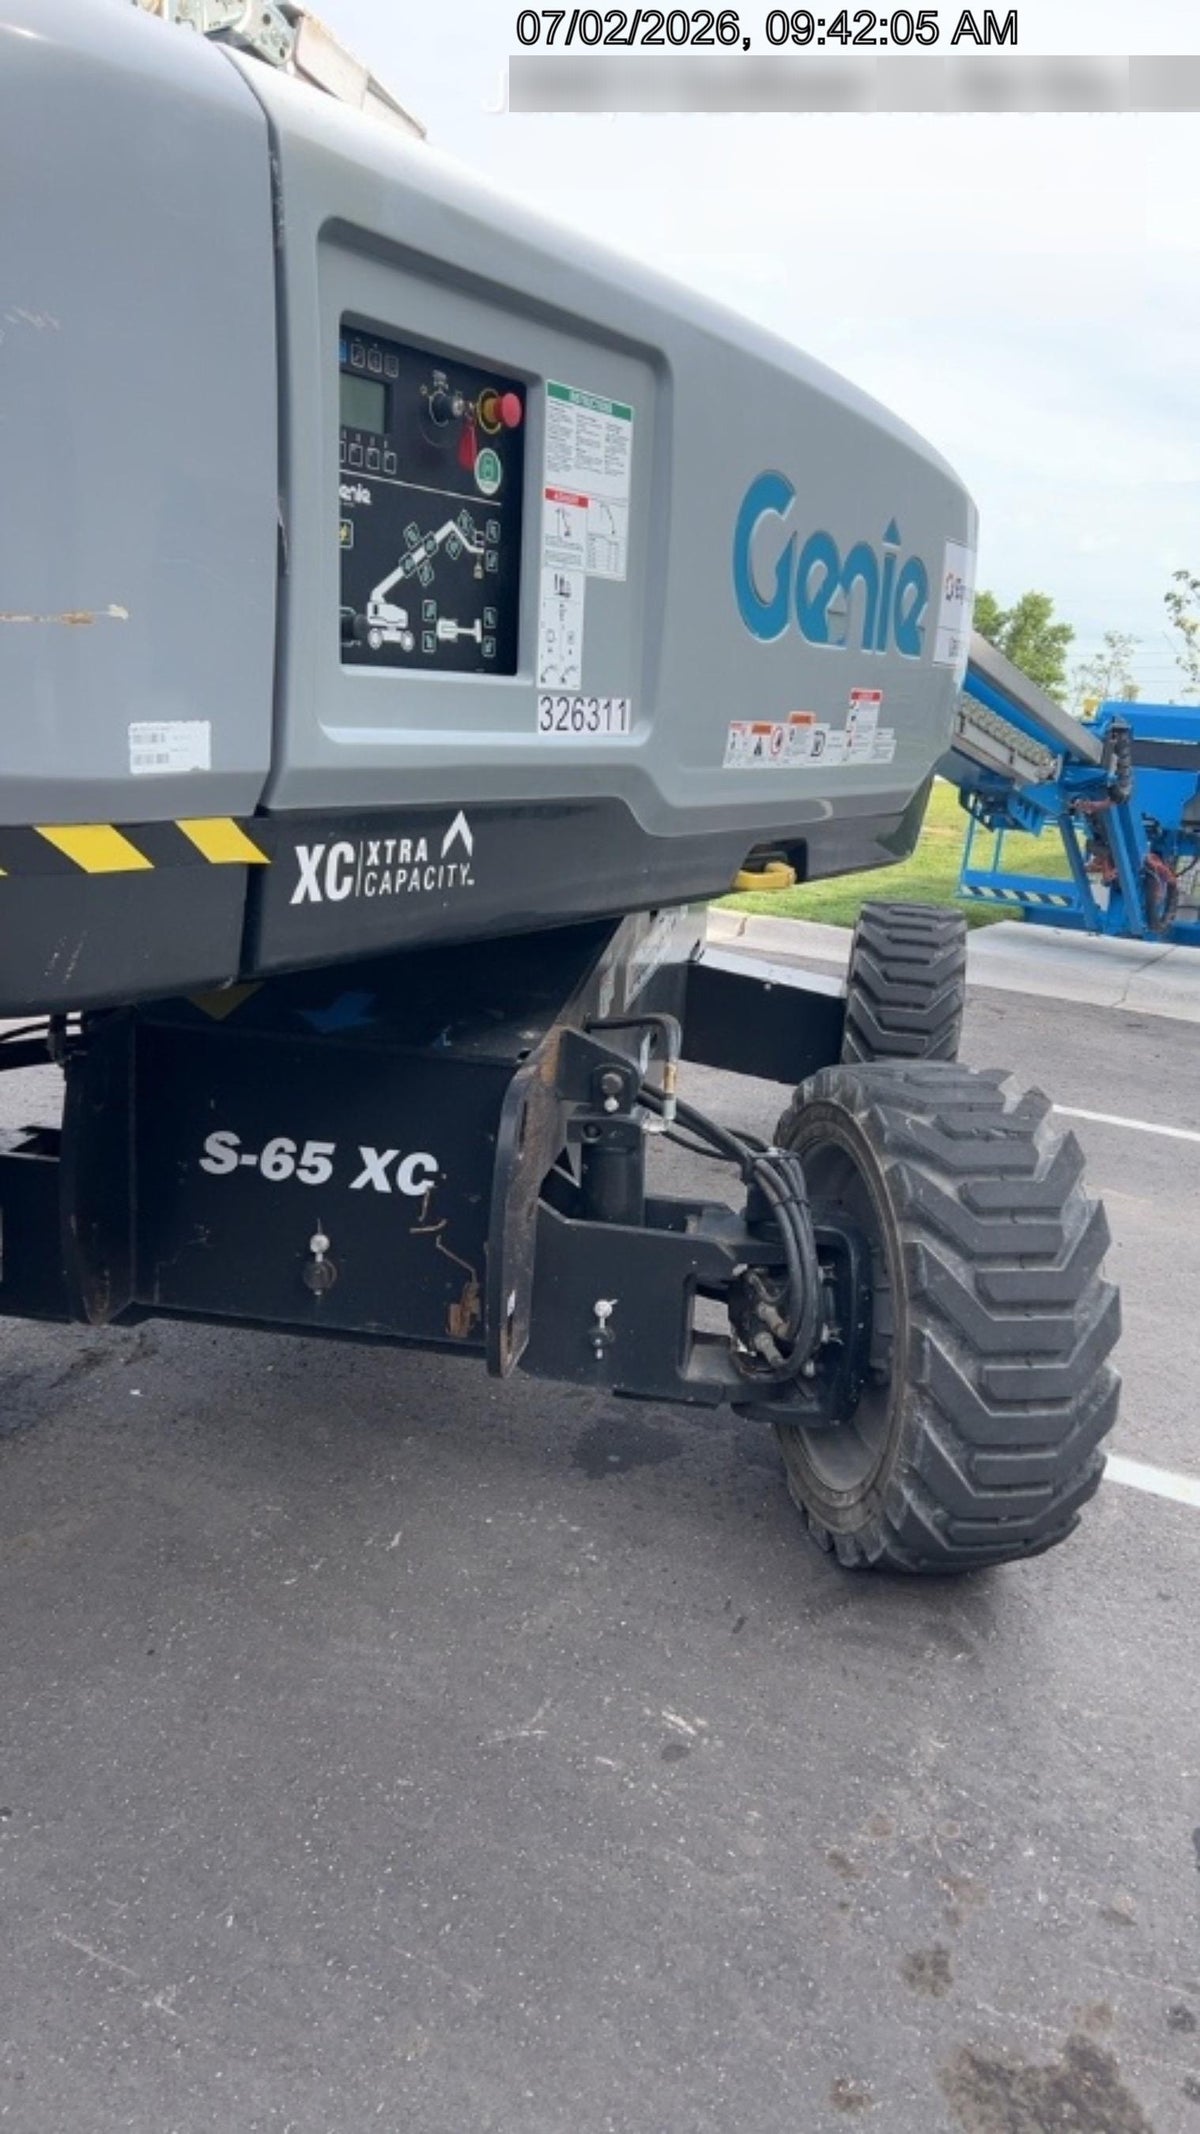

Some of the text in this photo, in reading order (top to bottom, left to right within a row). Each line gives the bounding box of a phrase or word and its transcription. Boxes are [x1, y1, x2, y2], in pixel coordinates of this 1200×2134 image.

[733, 469, 929, 660] Genie
[540, 695, 626, 731] 326311
[289, 841, 355, 905] XC
[365, 837, 429, 867] XTRA
[364, 862, 471, 897] CAPACITY
[199, 1130, 440, 1197] S-65 XC
